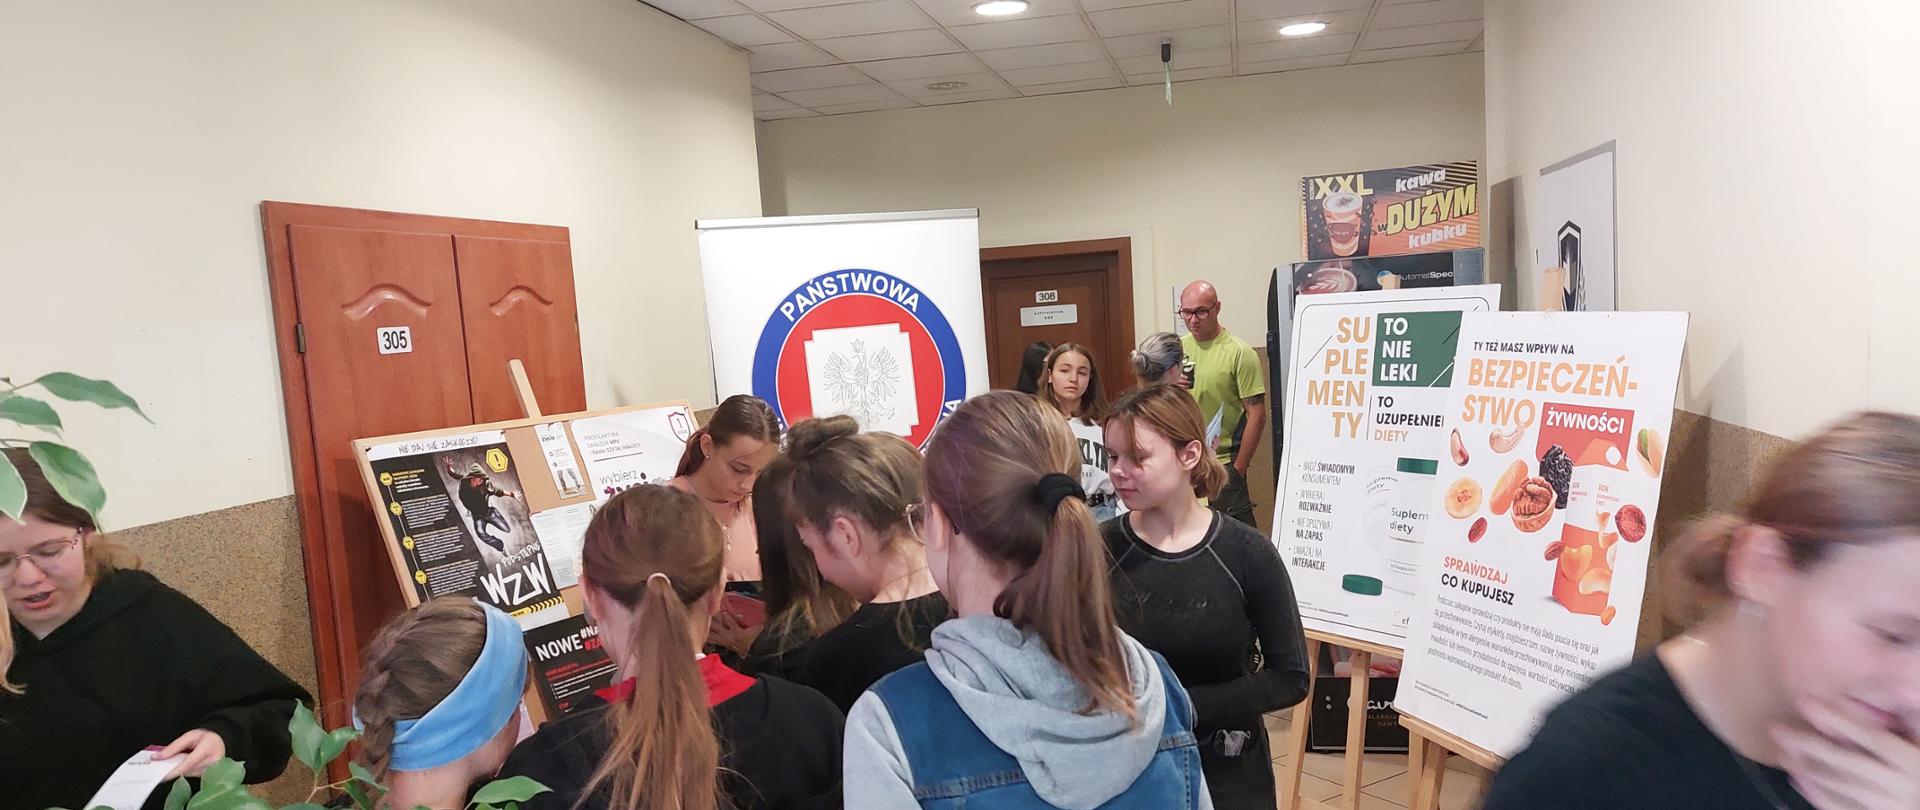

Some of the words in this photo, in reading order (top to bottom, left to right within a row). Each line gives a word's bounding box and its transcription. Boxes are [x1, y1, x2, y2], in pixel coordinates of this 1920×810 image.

[1315, 174, 1373, 200] XXL
[1395, 169, 1446, 192] kawa
[1386, 183, 1477, 236] DUŻYM
[1408, 223, 1467, 248] kubku
[780, 272, 919, 322] PAŃSTWOWA
[1039, 292, 1056, 301] 308
[1337, 316, 1370, 343] SU
[1384, 317, 1408, 335] TO
[382, 331, 407, 350] 305
[1382, 340, 1412, 358] NIE
[1474, 342, 1483, 350] TY
[1485, 339, 1498, 351] TEŻ
[1500, 343, 1524, 353] MASZ
[1526, 343, 1559, 355] WPŁYW
[1561, 344, 1575, 354] NA
[1325, 348, 1368, 375] PLE
[1380, 363, 1417, 381] LEKI
[1467, 355, 1638, 398] BEZPIECZEŃ-
[1308, 380, 1365, 406] MEN
[1378, 396, 1393, 407] TO
[1462, 394, 1535, 430] STWO
[1546, 407, 1625, 434] ŻYWNOŚCI
[1332, 411, 1363, 438] TY
[1374, 430, 1408, 442] DIETY
[600, 470, 638, 486] wybierz
[1317, 460, 1355, 475] ŚWIADOMYM
[1299, 501, 1332, 513] ROZWAŻNIE
[1296, 529, 1304, 538] NA
[1305, 530, 1323, 541] ZAPAS
[1389, 521, 1414, 534] diety
[1292, 556, 1326, 571] INTERAKCJE
[1443, 556, 1508, 585] SPRAWDZAJ
[480, 553, 551, 606] WZW
[1441, 573, 1458, 588] CO
[1461, 579, 1515, 606] KUPUJESZ
[535, 634, 583, 662] NOWE
